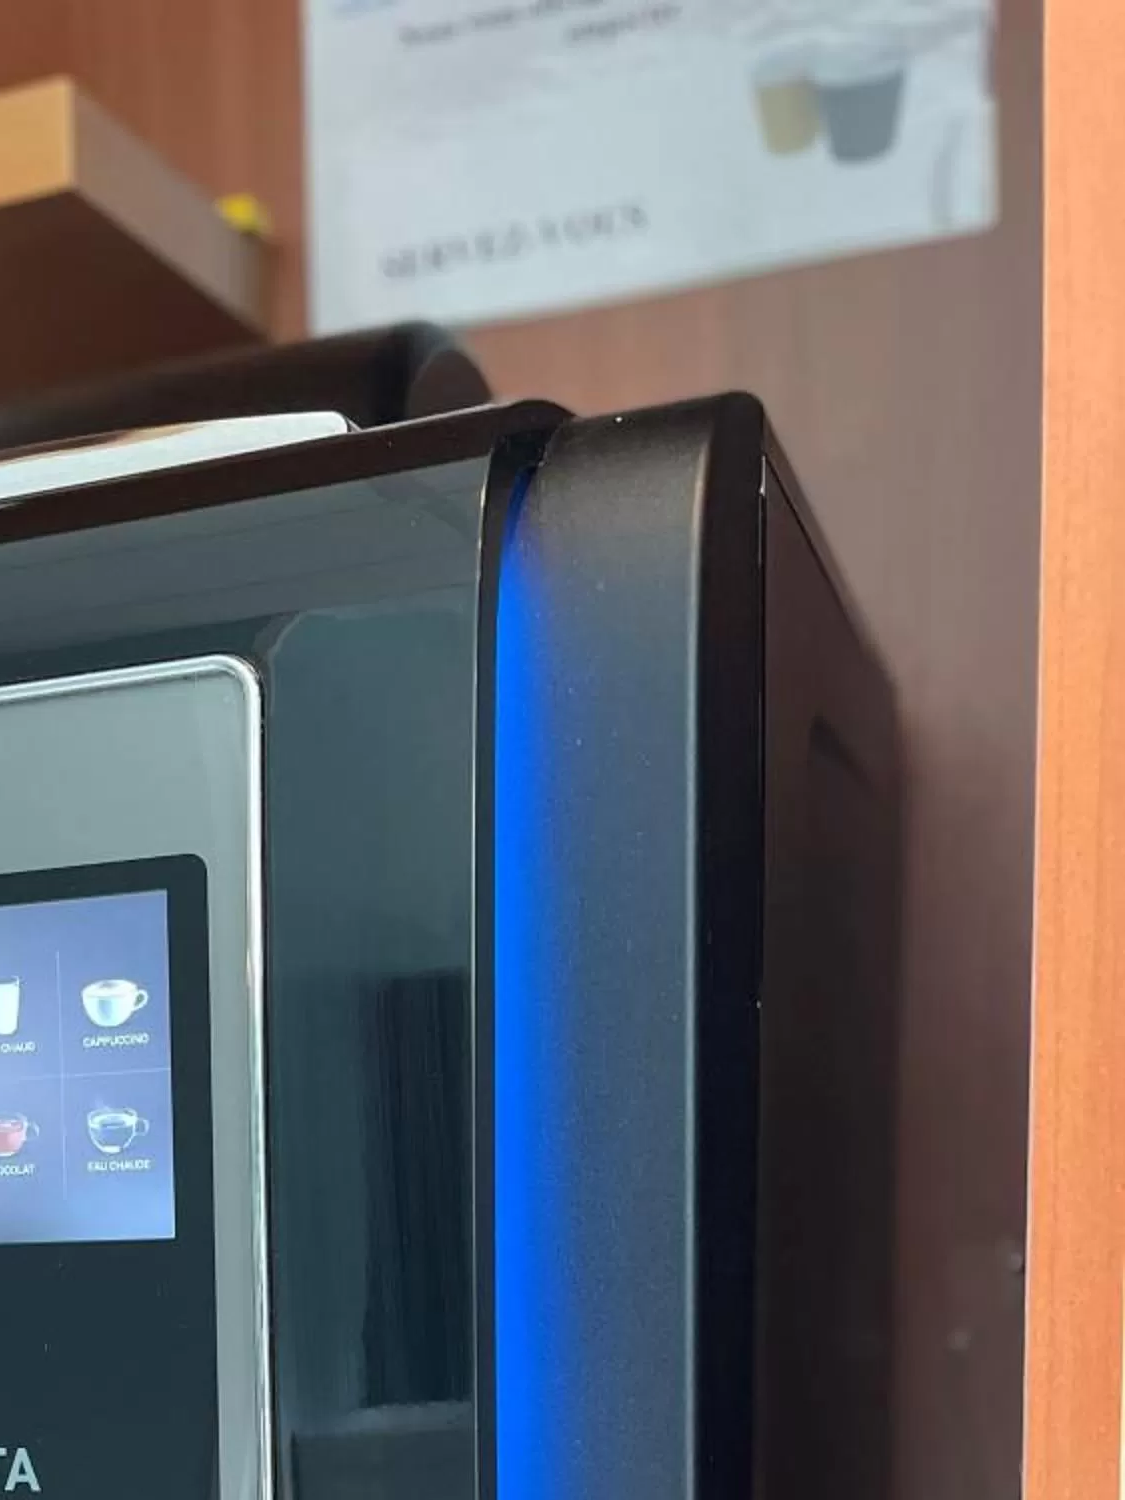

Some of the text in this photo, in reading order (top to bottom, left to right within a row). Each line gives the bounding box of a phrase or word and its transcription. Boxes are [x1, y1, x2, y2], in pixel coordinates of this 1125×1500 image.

[82, 1032, 150, 1049] CAPPUCCINO
[87, 1159, 152, 1173] EAU CHAUDE
